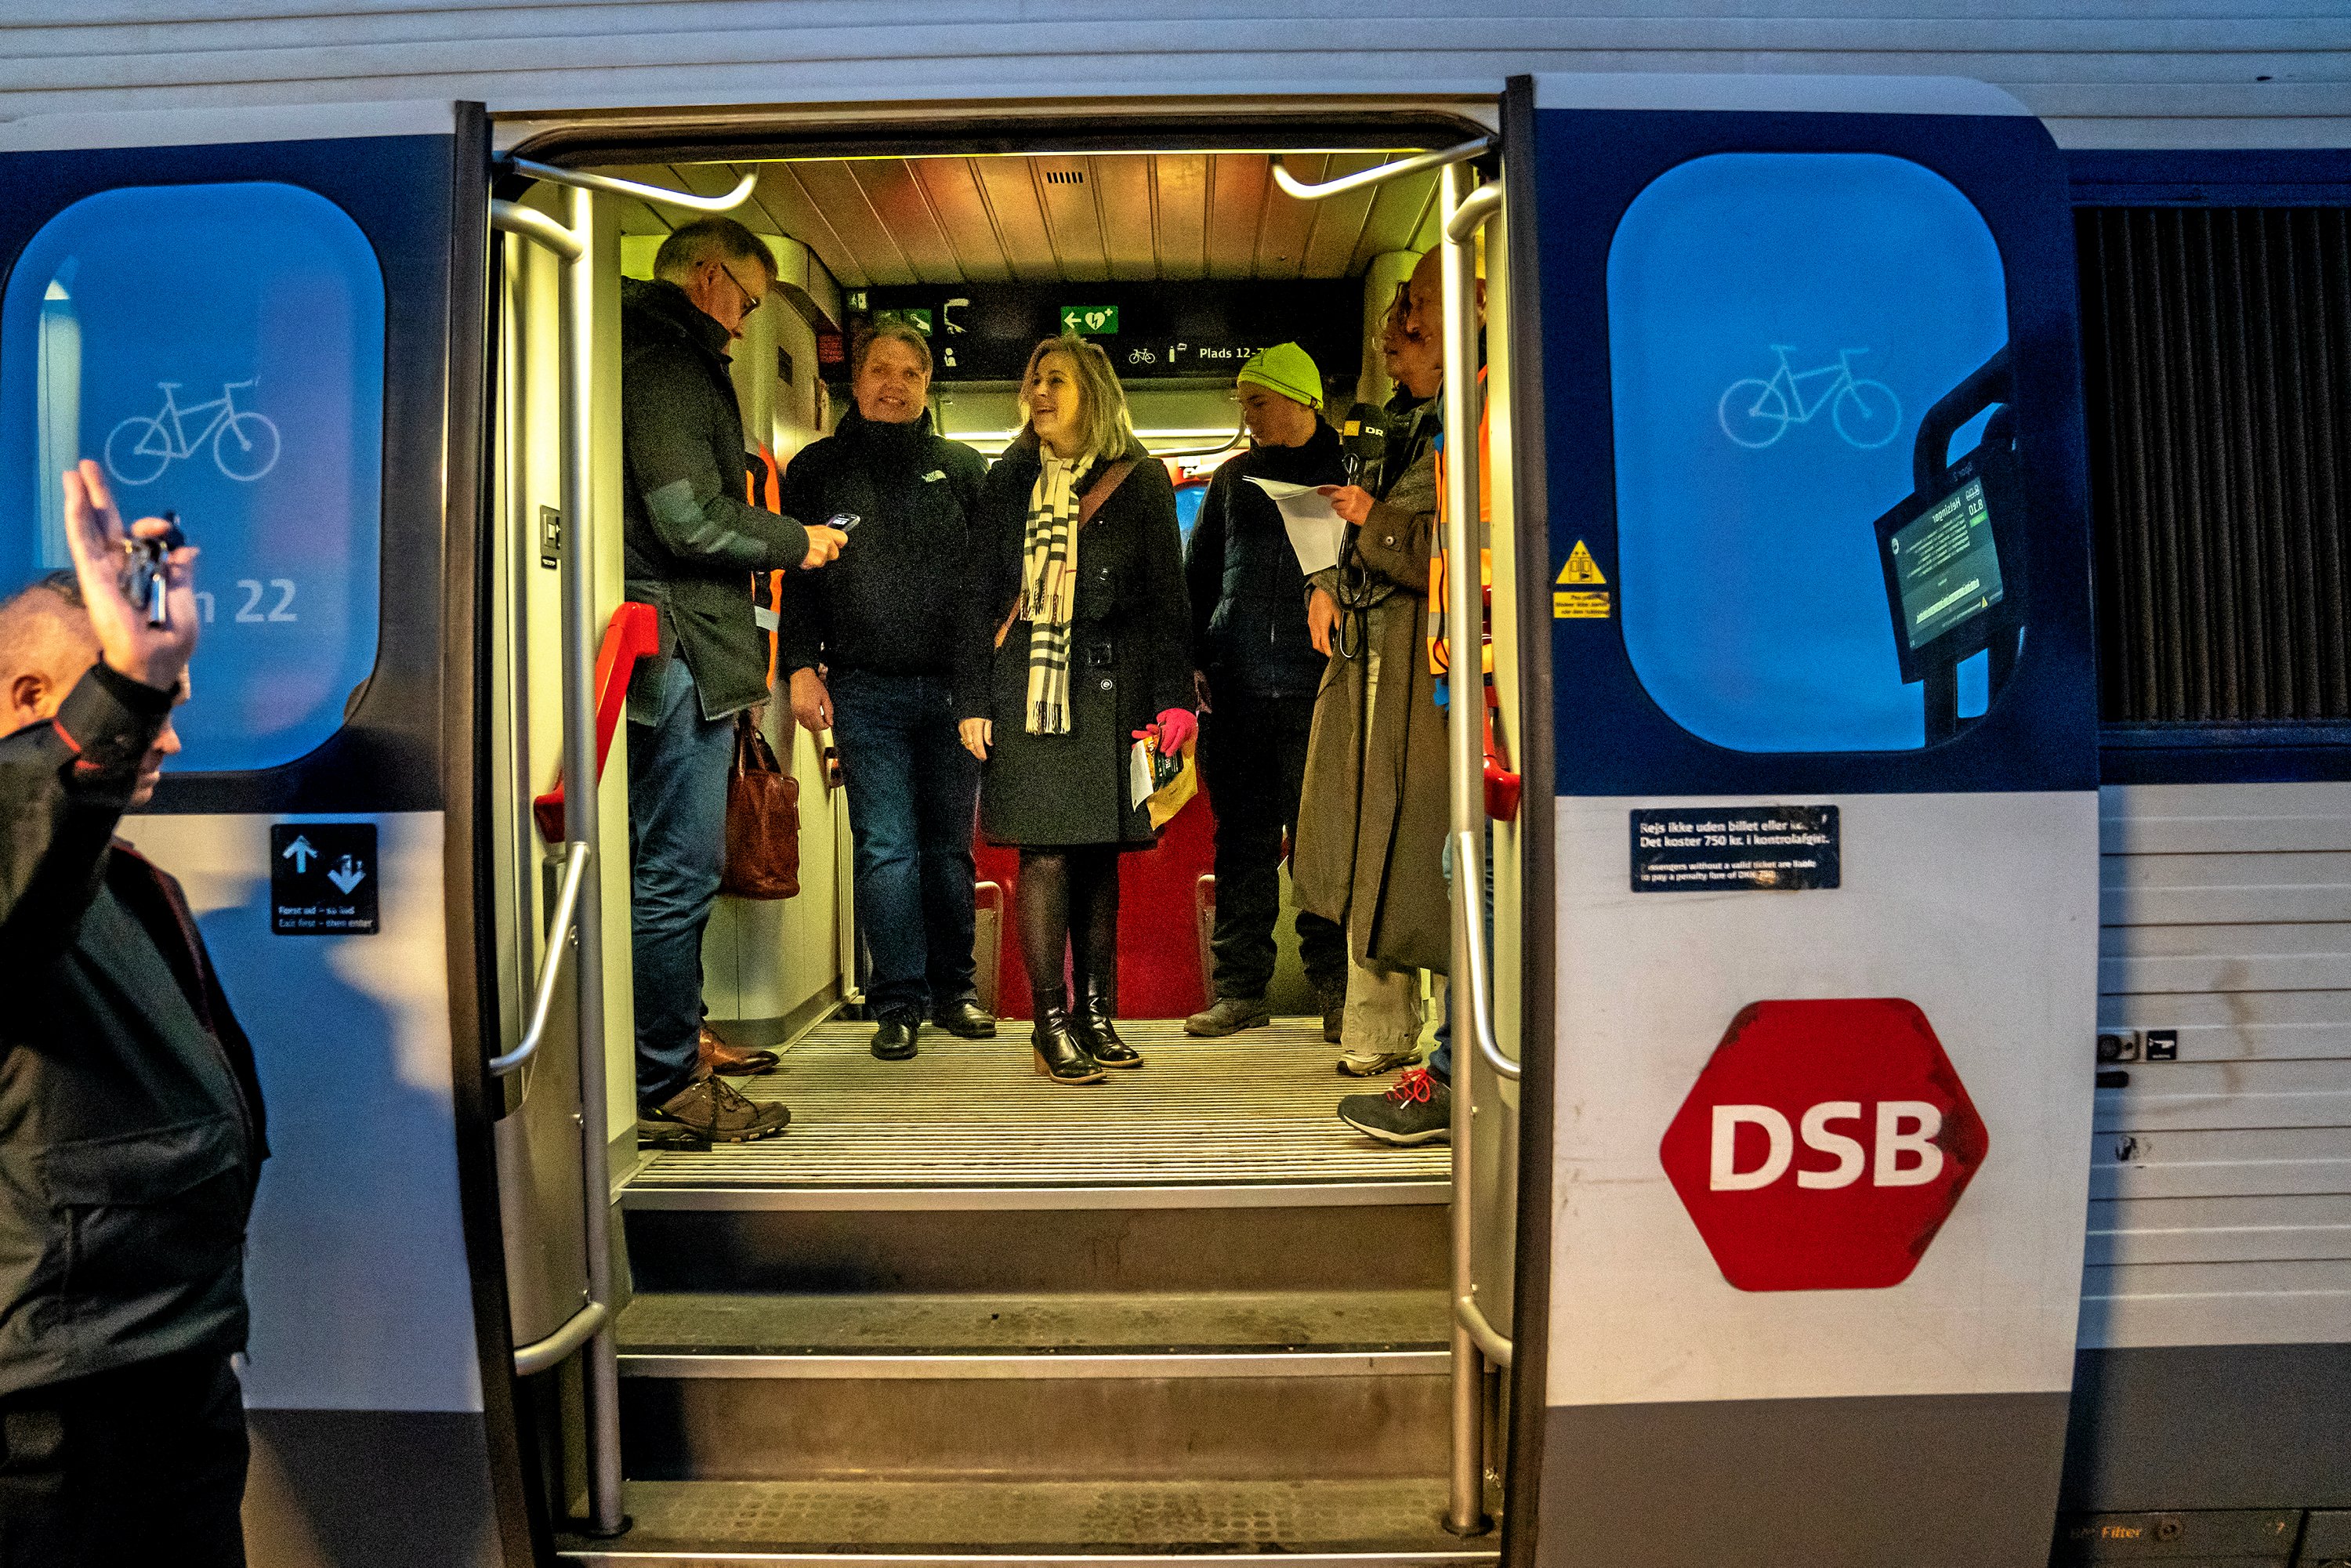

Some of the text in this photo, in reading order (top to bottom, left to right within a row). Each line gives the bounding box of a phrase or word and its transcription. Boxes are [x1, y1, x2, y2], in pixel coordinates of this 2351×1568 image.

[1200, 348, 1232, 358] Plads
[1365, 426, 1384, 436] DR
[236, 578, 297, 622] 22
[1640, 822, 1666, 835] Rejs
[1668, 821, 1694, 833] ikke
[1696, 820, 1726, 832] uden
[1728, 820, 1759, 831] billet
[1760, 819, 1788, 831] eller
[1640, 835, 1662, 847] Det
[1664, 835, 1702, 847] koster
[1704, 835, 1727, 846] 750
[1688, 862, 1723, 871] without
[1730, 860, 1752, 870] valid
[1709, 1100, 1943, 1191] DSB
